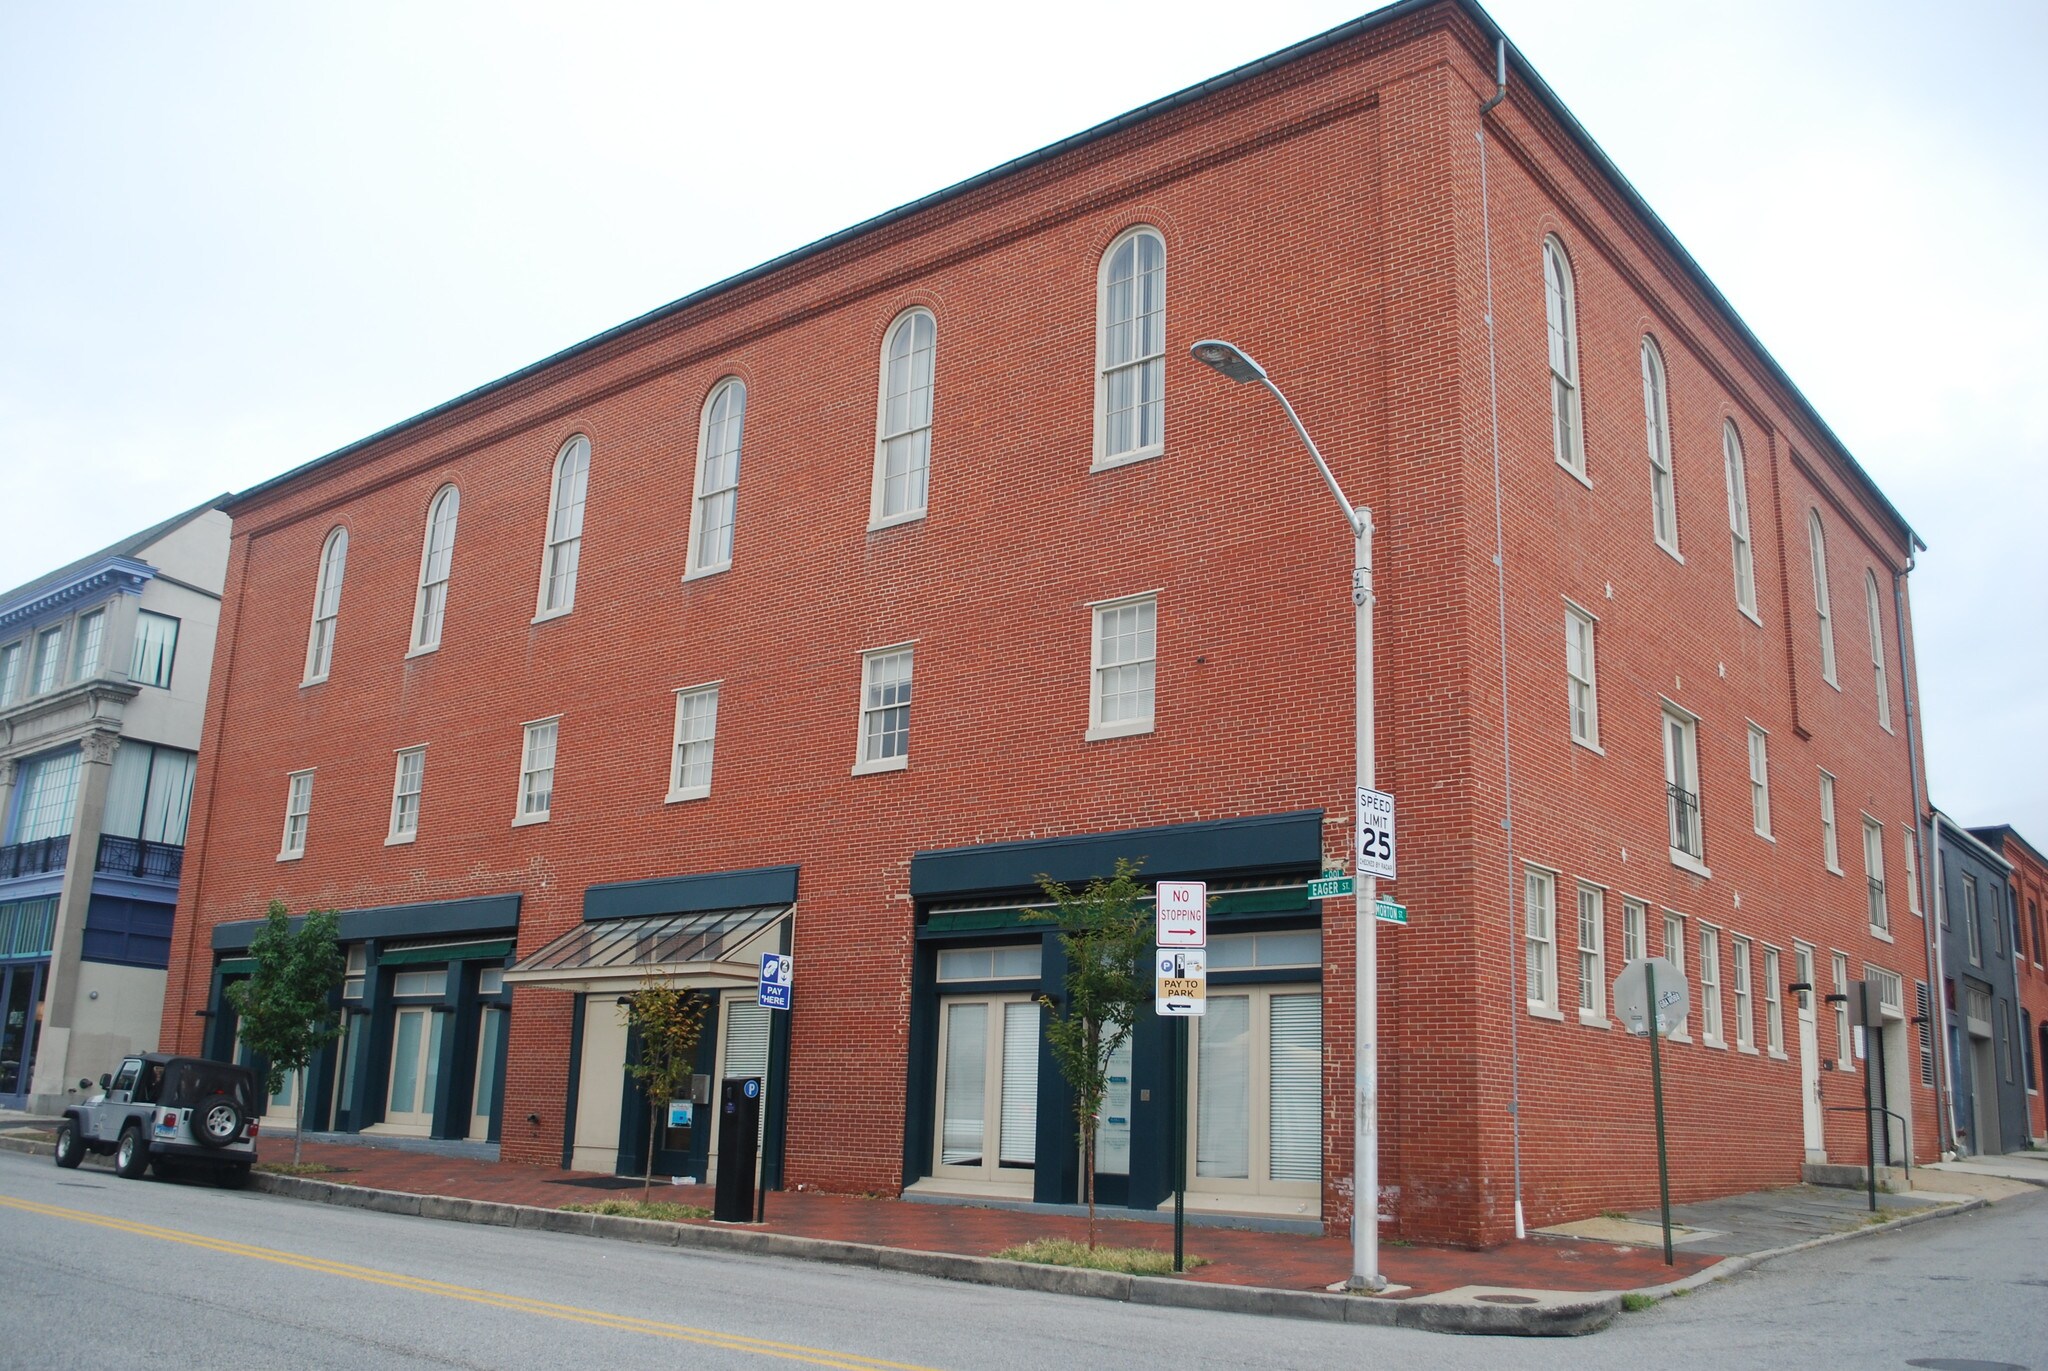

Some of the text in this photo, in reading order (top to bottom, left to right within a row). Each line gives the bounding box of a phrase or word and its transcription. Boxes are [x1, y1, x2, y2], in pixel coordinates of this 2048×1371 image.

[1361, 794, 1391, 813] SPEED
[1364, 812, 1388, 830] LIMIT
[1363, 827, 1391, 861] 25
[1312, 881, 1339, 896] EAGER
[1172, 890, 1189, 903] NO
[1161, 909, 1202, 921] STOPPING
[1376, 903, 1398, 920] MORTON
[767, 986, 783, 995] PAY
[1164, 980, 1198, 989] PAY TO
[1167, 989, 1194, 997] PARK
[763, 995, 785, 1005] HERE
